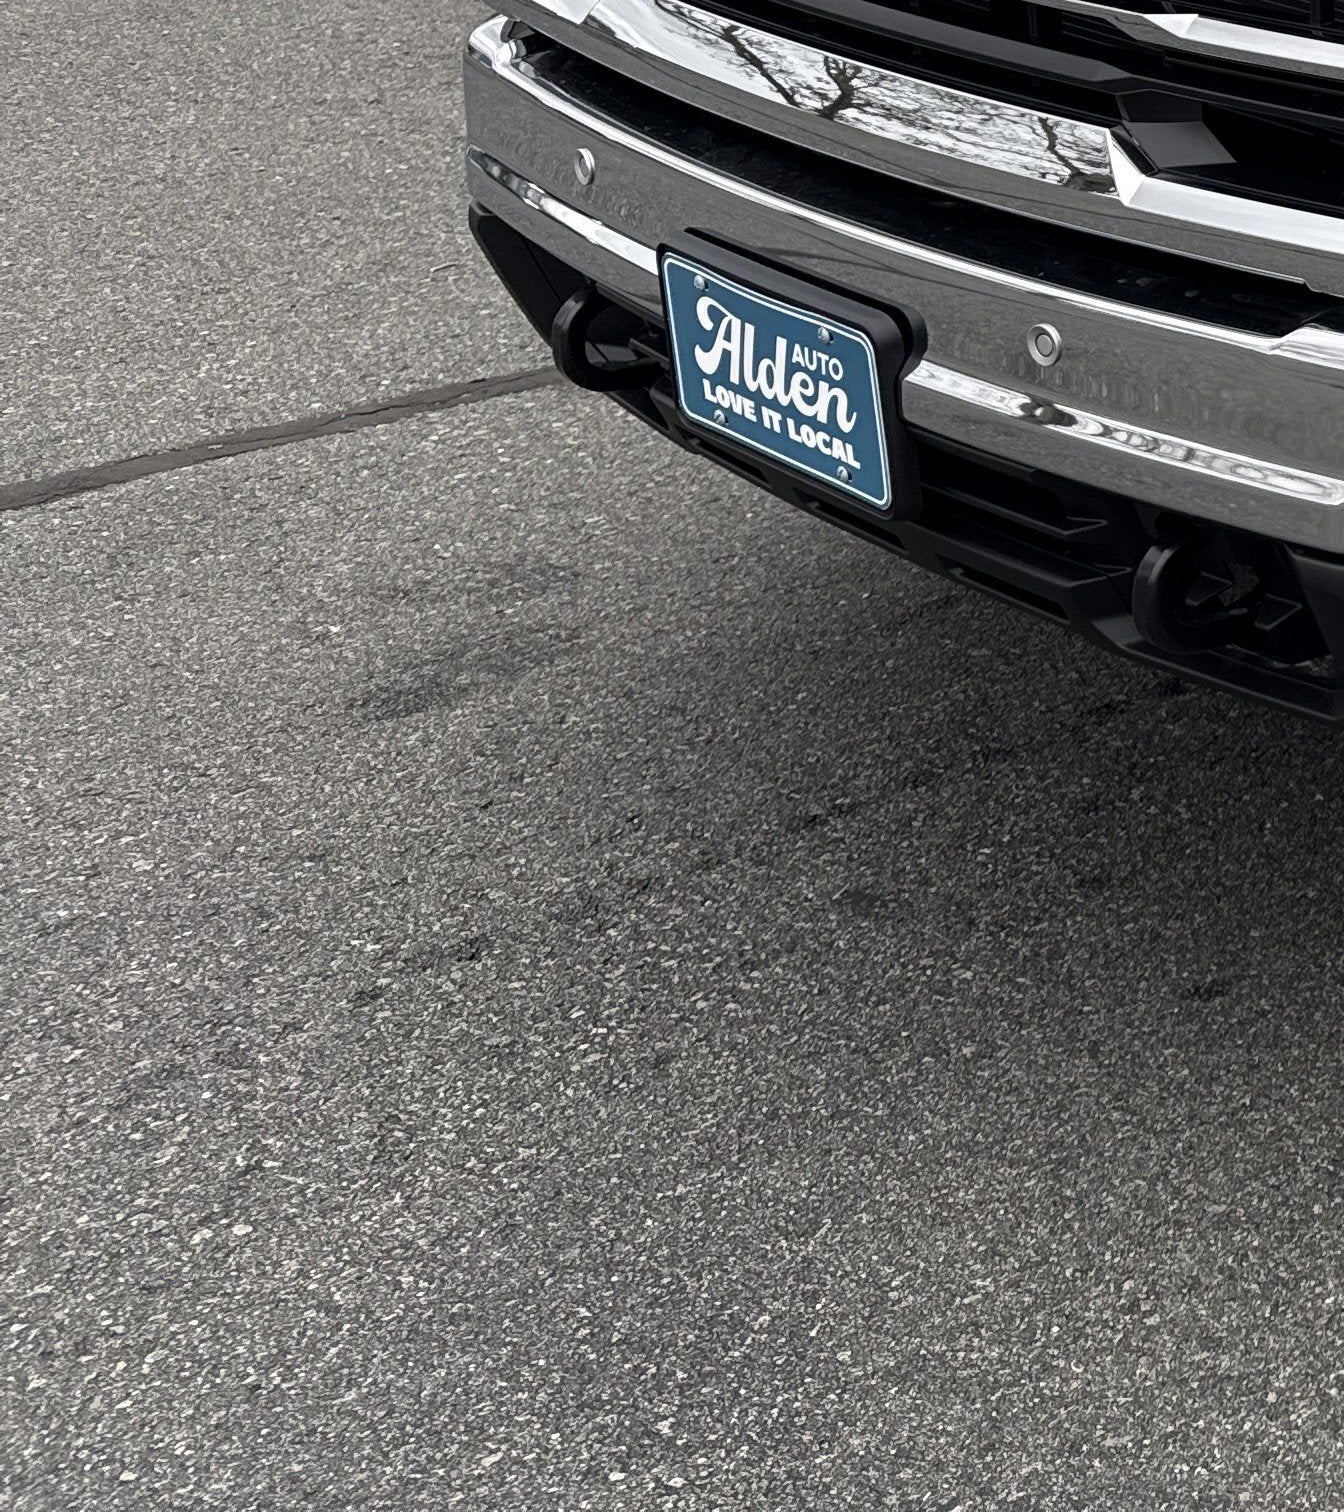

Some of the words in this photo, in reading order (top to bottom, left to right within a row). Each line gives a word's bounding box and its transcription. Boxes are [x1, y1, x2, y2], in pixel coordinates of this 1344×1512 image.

[694, 296, 857, 433] Alden
[791, 343, 843, 381] AUTO
[703, 378, 757, 422] LOVE
[761, 405, 782, 433] IT
[786, 417, 861, 469] LOCAL
